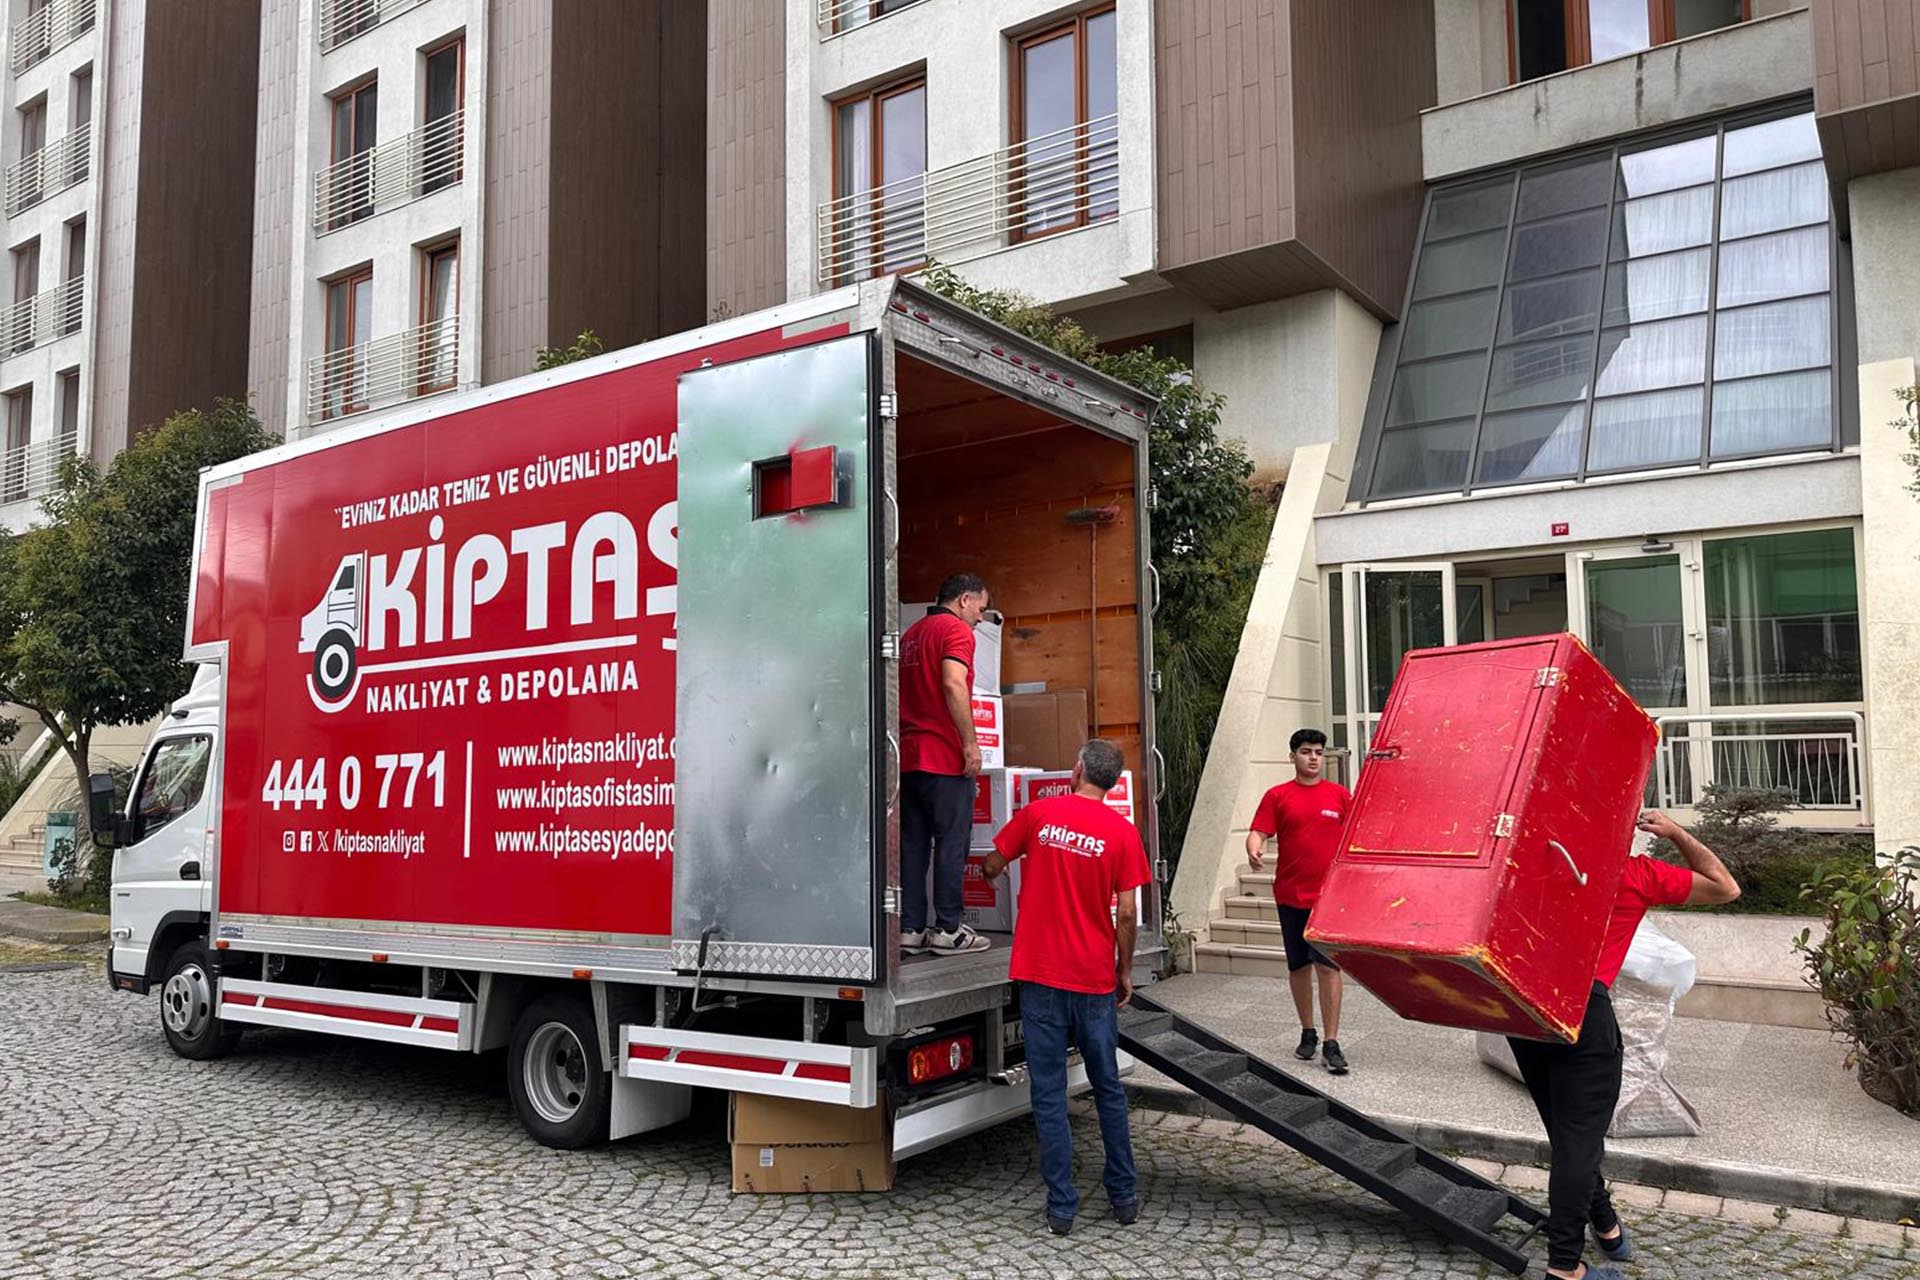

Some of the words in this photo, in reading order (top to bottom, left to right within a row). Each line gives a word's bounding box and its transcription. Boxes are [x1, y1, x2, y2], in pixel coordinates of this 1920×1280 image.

[389, 486, 439, 519] KADAR
[497, 468, 519, 496] VE
[477, 674, 492, 705] &
[501, 660, 639, 701] DEPOLAMA
[262, 757, 327, 811] 444
[339, 755, 361, 811] 0
[375, 750, 446, 809] 771
[333, 829, 425, 859] /kiptasnakliyat
